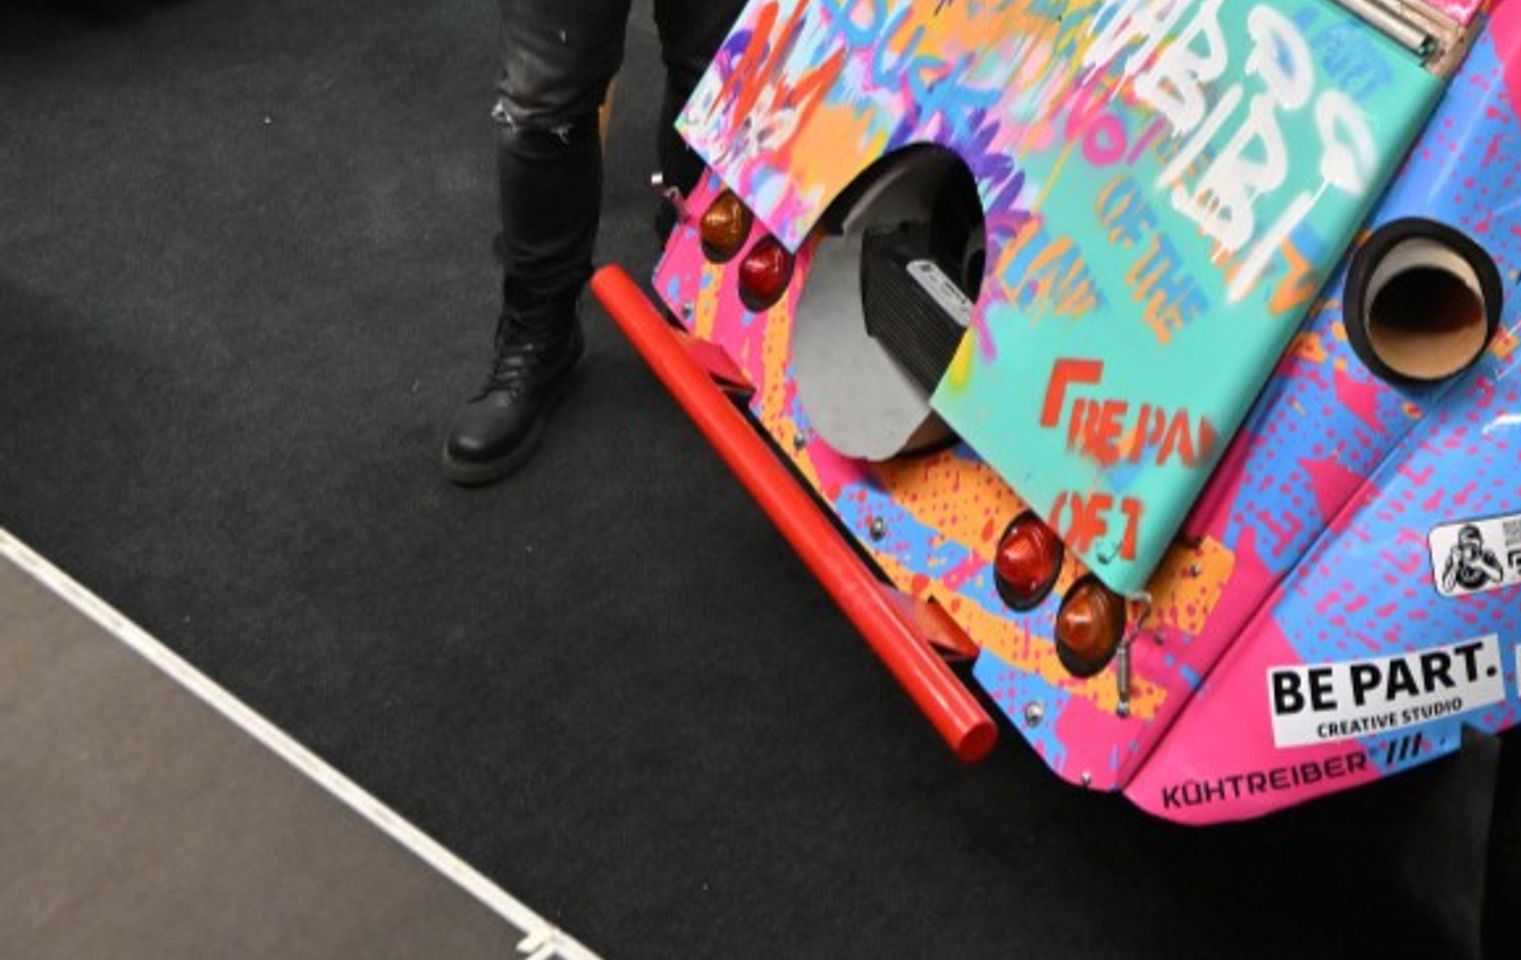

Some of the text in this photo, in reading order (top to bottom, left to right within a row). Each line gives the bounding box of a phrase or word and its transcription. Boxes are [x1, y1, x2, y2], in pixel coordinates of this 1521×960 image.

[1272, 640, 1498, 716] BE PART.
[1317, 696, 1464, 739] CREATIVE STUDIO
[1161, 748, 1367, 809] KÜHTREIBER
